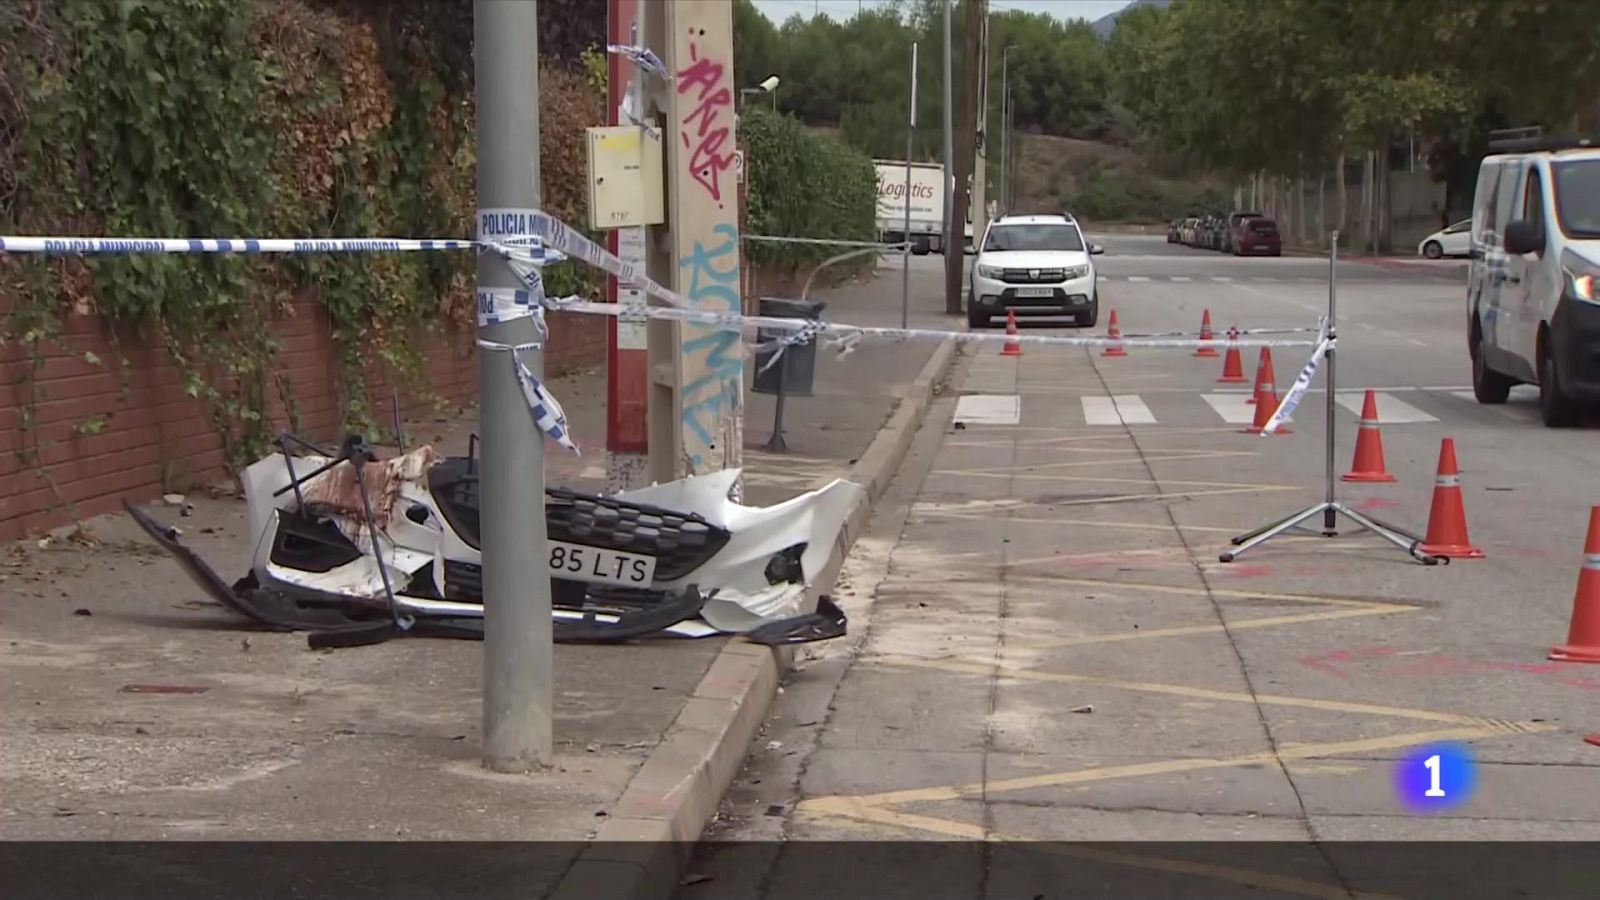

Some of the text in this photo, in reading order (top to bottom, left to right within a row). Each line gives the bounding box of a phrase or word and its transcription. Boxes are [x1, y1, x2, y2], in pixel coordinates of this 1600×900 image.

[880, 180, 933, 200] Logitics
[482, 214, 525, 235] POLICIA
[549, 547, 648, 582] 85 LTS
